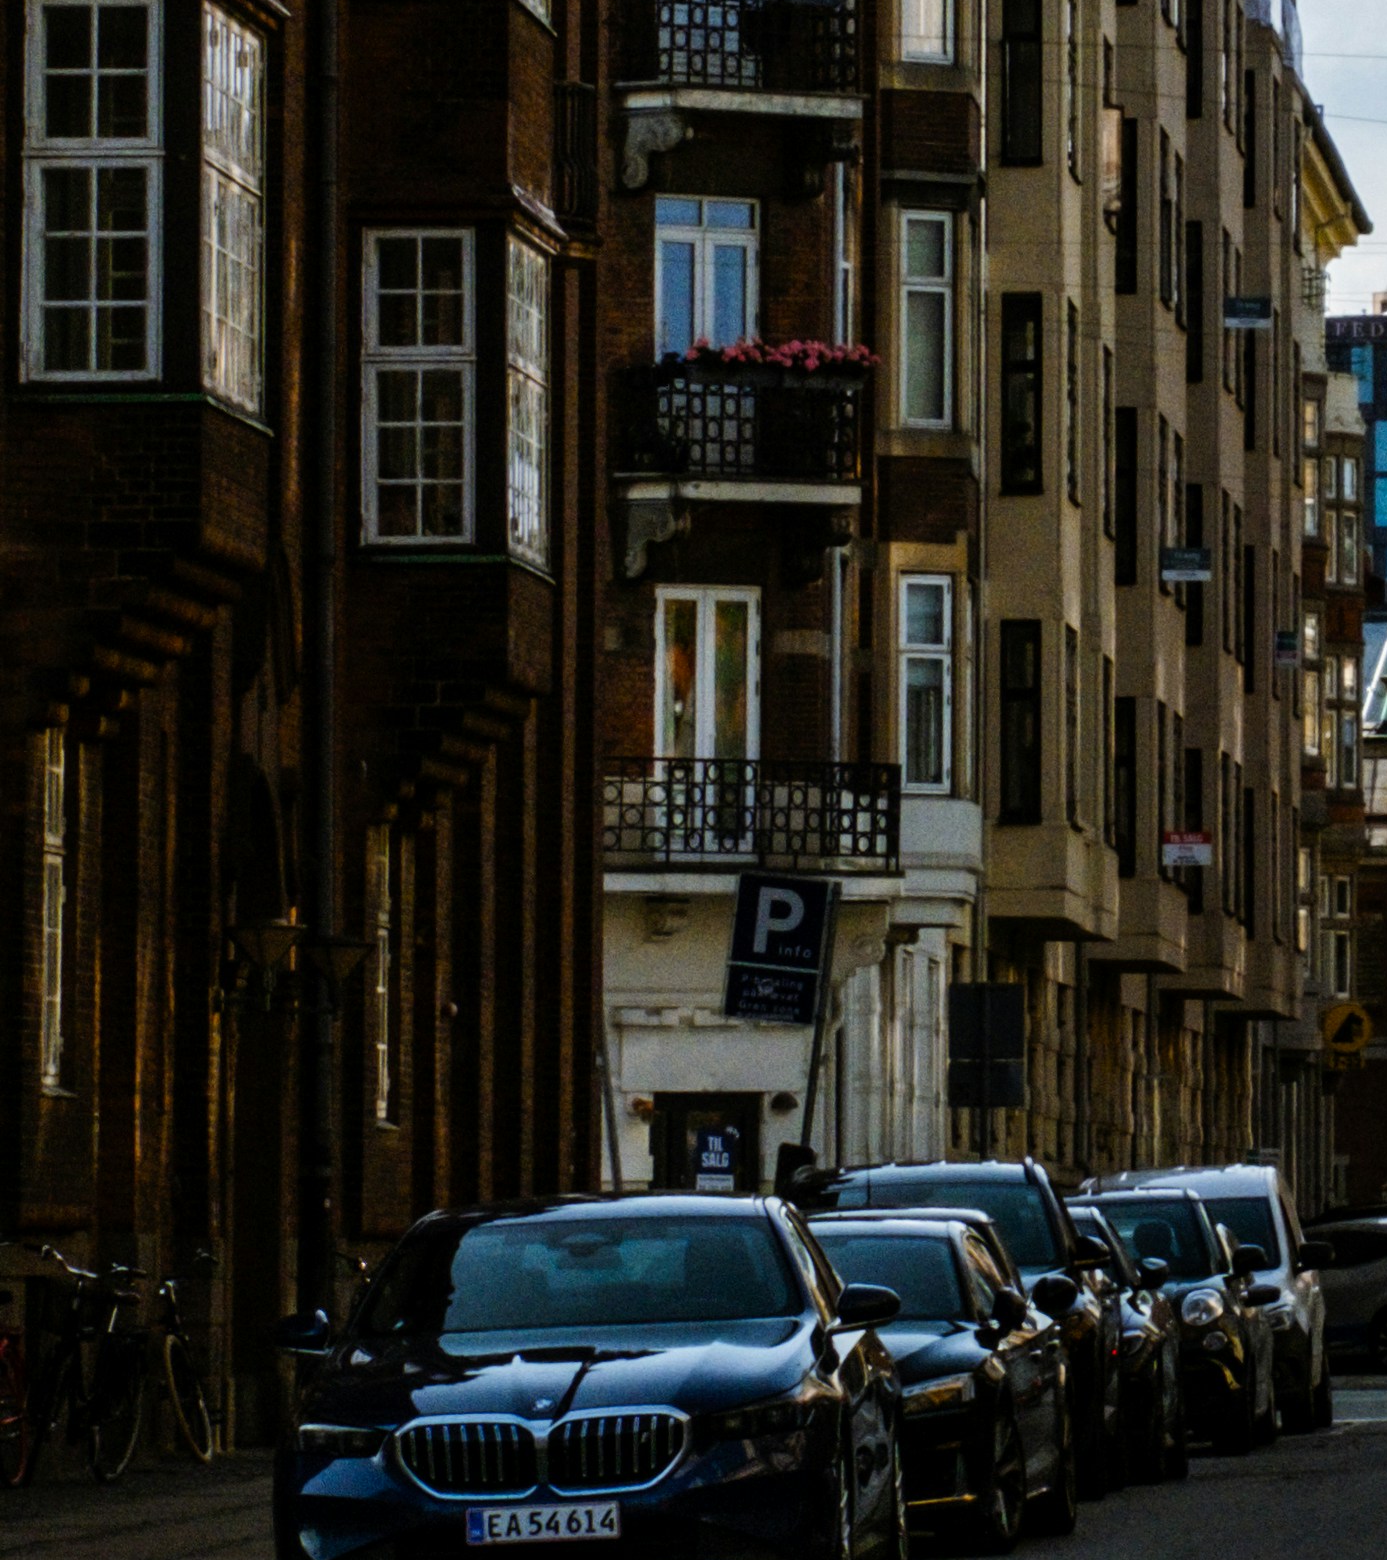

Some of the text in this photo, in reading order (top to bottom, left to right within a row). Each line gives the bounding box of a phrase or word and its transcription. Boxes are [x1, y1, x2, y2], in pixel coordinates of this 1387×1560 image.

[753, 885, 805, 954] P
[778, 942, 813, 959] info
[706, 1135, 723, 1152] TIL
[701, 1152, 729, 1168] SALG
[488, 1508, 615, 1537] EA 54 614
